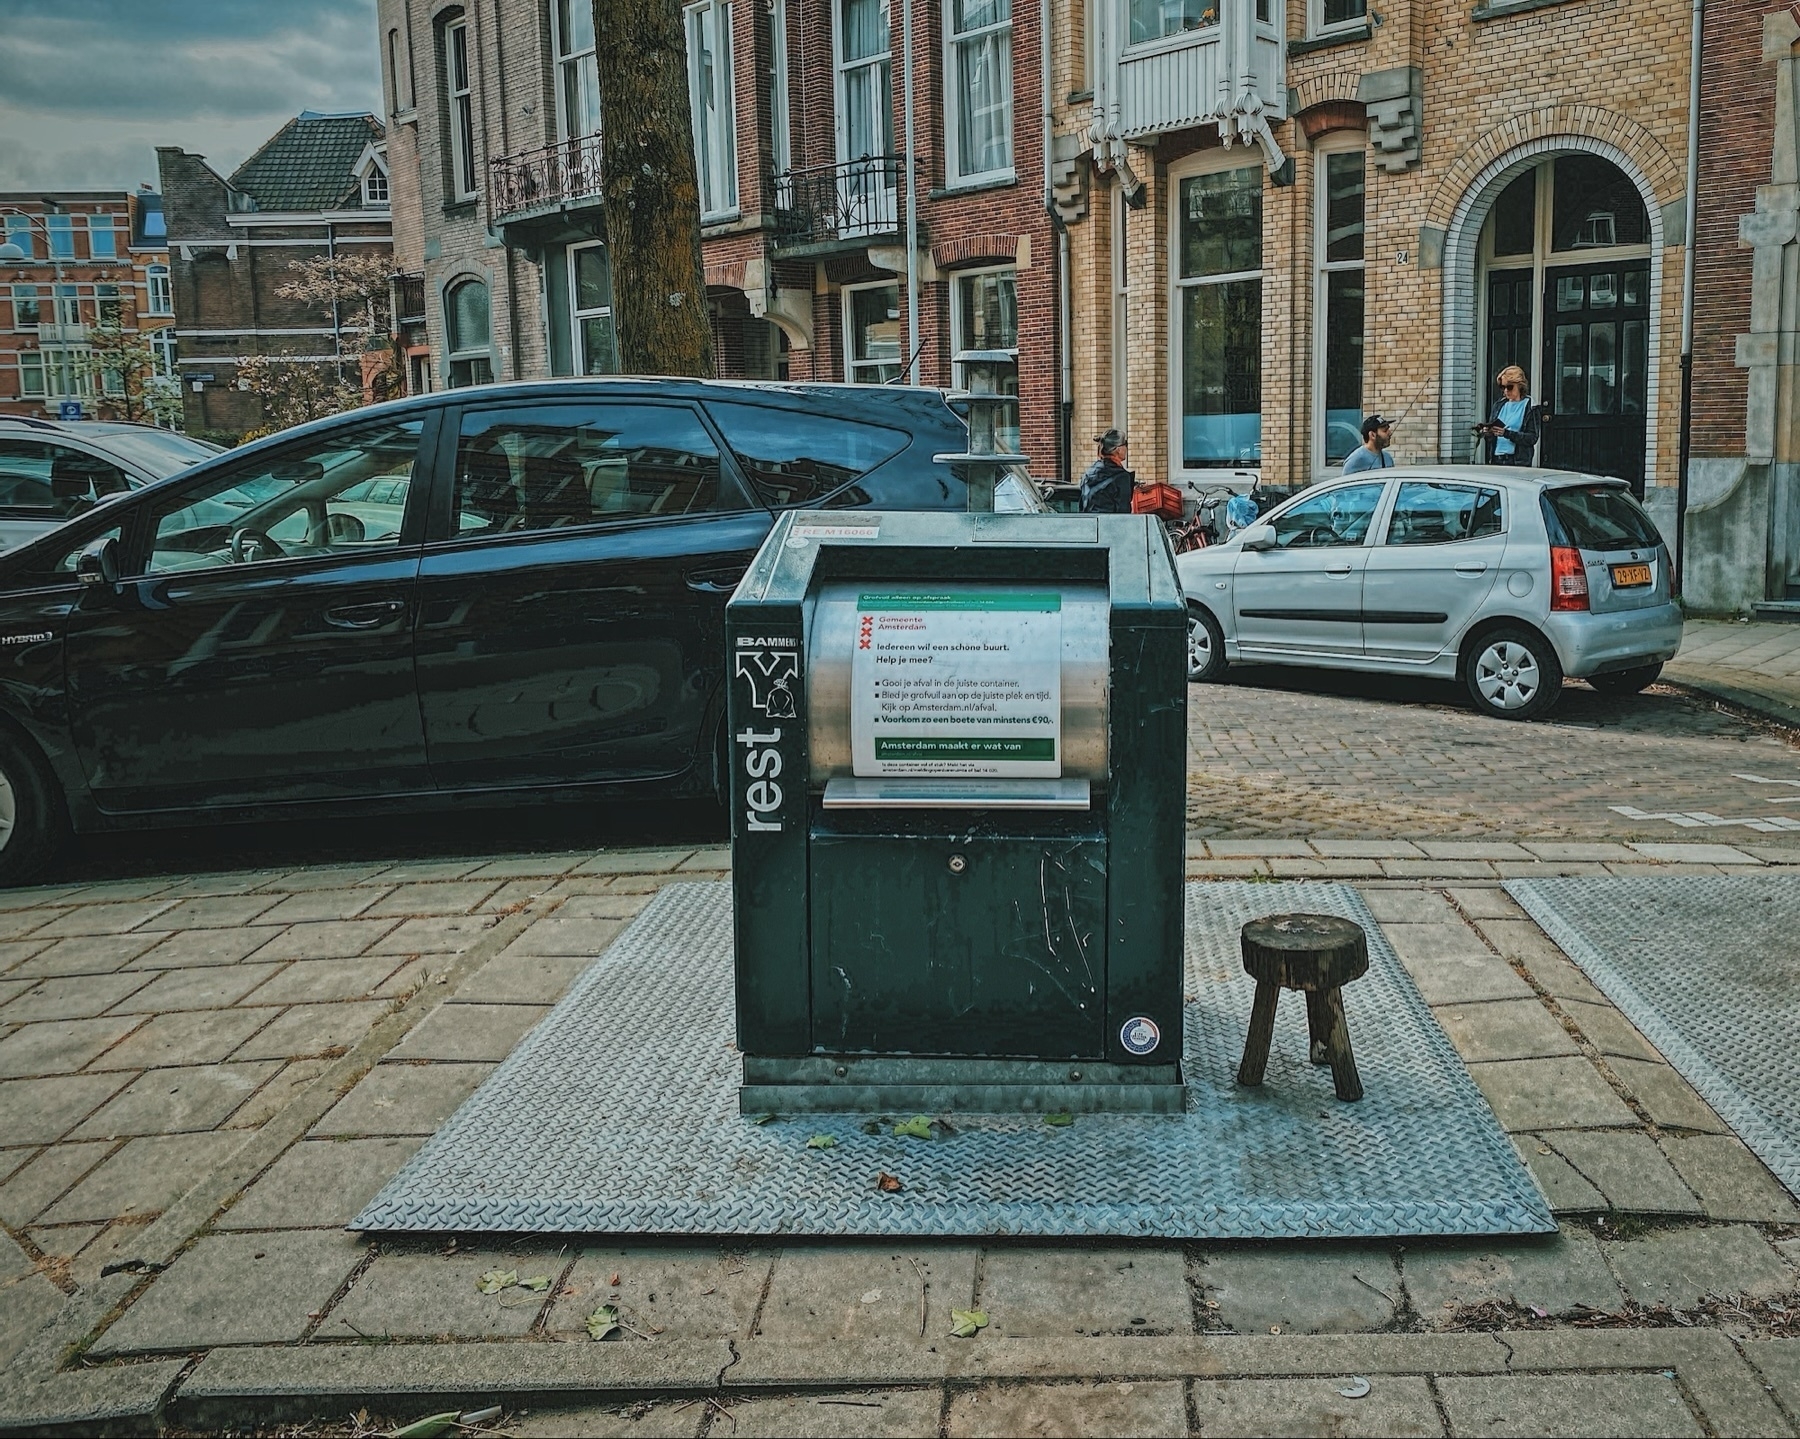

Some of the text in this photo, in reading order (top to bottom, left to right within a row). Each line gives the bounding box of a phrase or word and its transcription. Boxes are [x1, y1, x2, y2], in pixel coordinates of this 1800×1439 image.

[1397, 252, 1408, 264] 24
[1, 633, 46, 645] HYBRID
[877, 643, 915, 651] Iedereen
[917, 643, 931, 651] wil
[950, 643, 981, 651] schone
[983, 643, 1010, 651] buurt.
[876, 656, 933, 665] Help je mee?
[881, 679, 1020, 689] Gooi je afval in de juiste container.
[881, 691, 900, 699] Bied
[901, 691, 909, 701] je
[910, 691, 940, 701] grofvuil
[957, 693, 969, 701] op
[970, 691, 982, 699] de
[983, 691, 1004, 701] juiste
[1005, 691, 1023, 701] plek
[1036, 691, 1051, 702] tijd.
[881, 703, 997, 713] Kijk op Amsterdam.nl/afval.
[881, 715, 920, 723] Voorkom
[950, 715, 976, 723] boete
[880, 741, 937, 750] Amsterdam
[938, 741, 969, 750] maakt
[983, 742, 1002, 750] wat
[736, 727, 783, 831] rest
